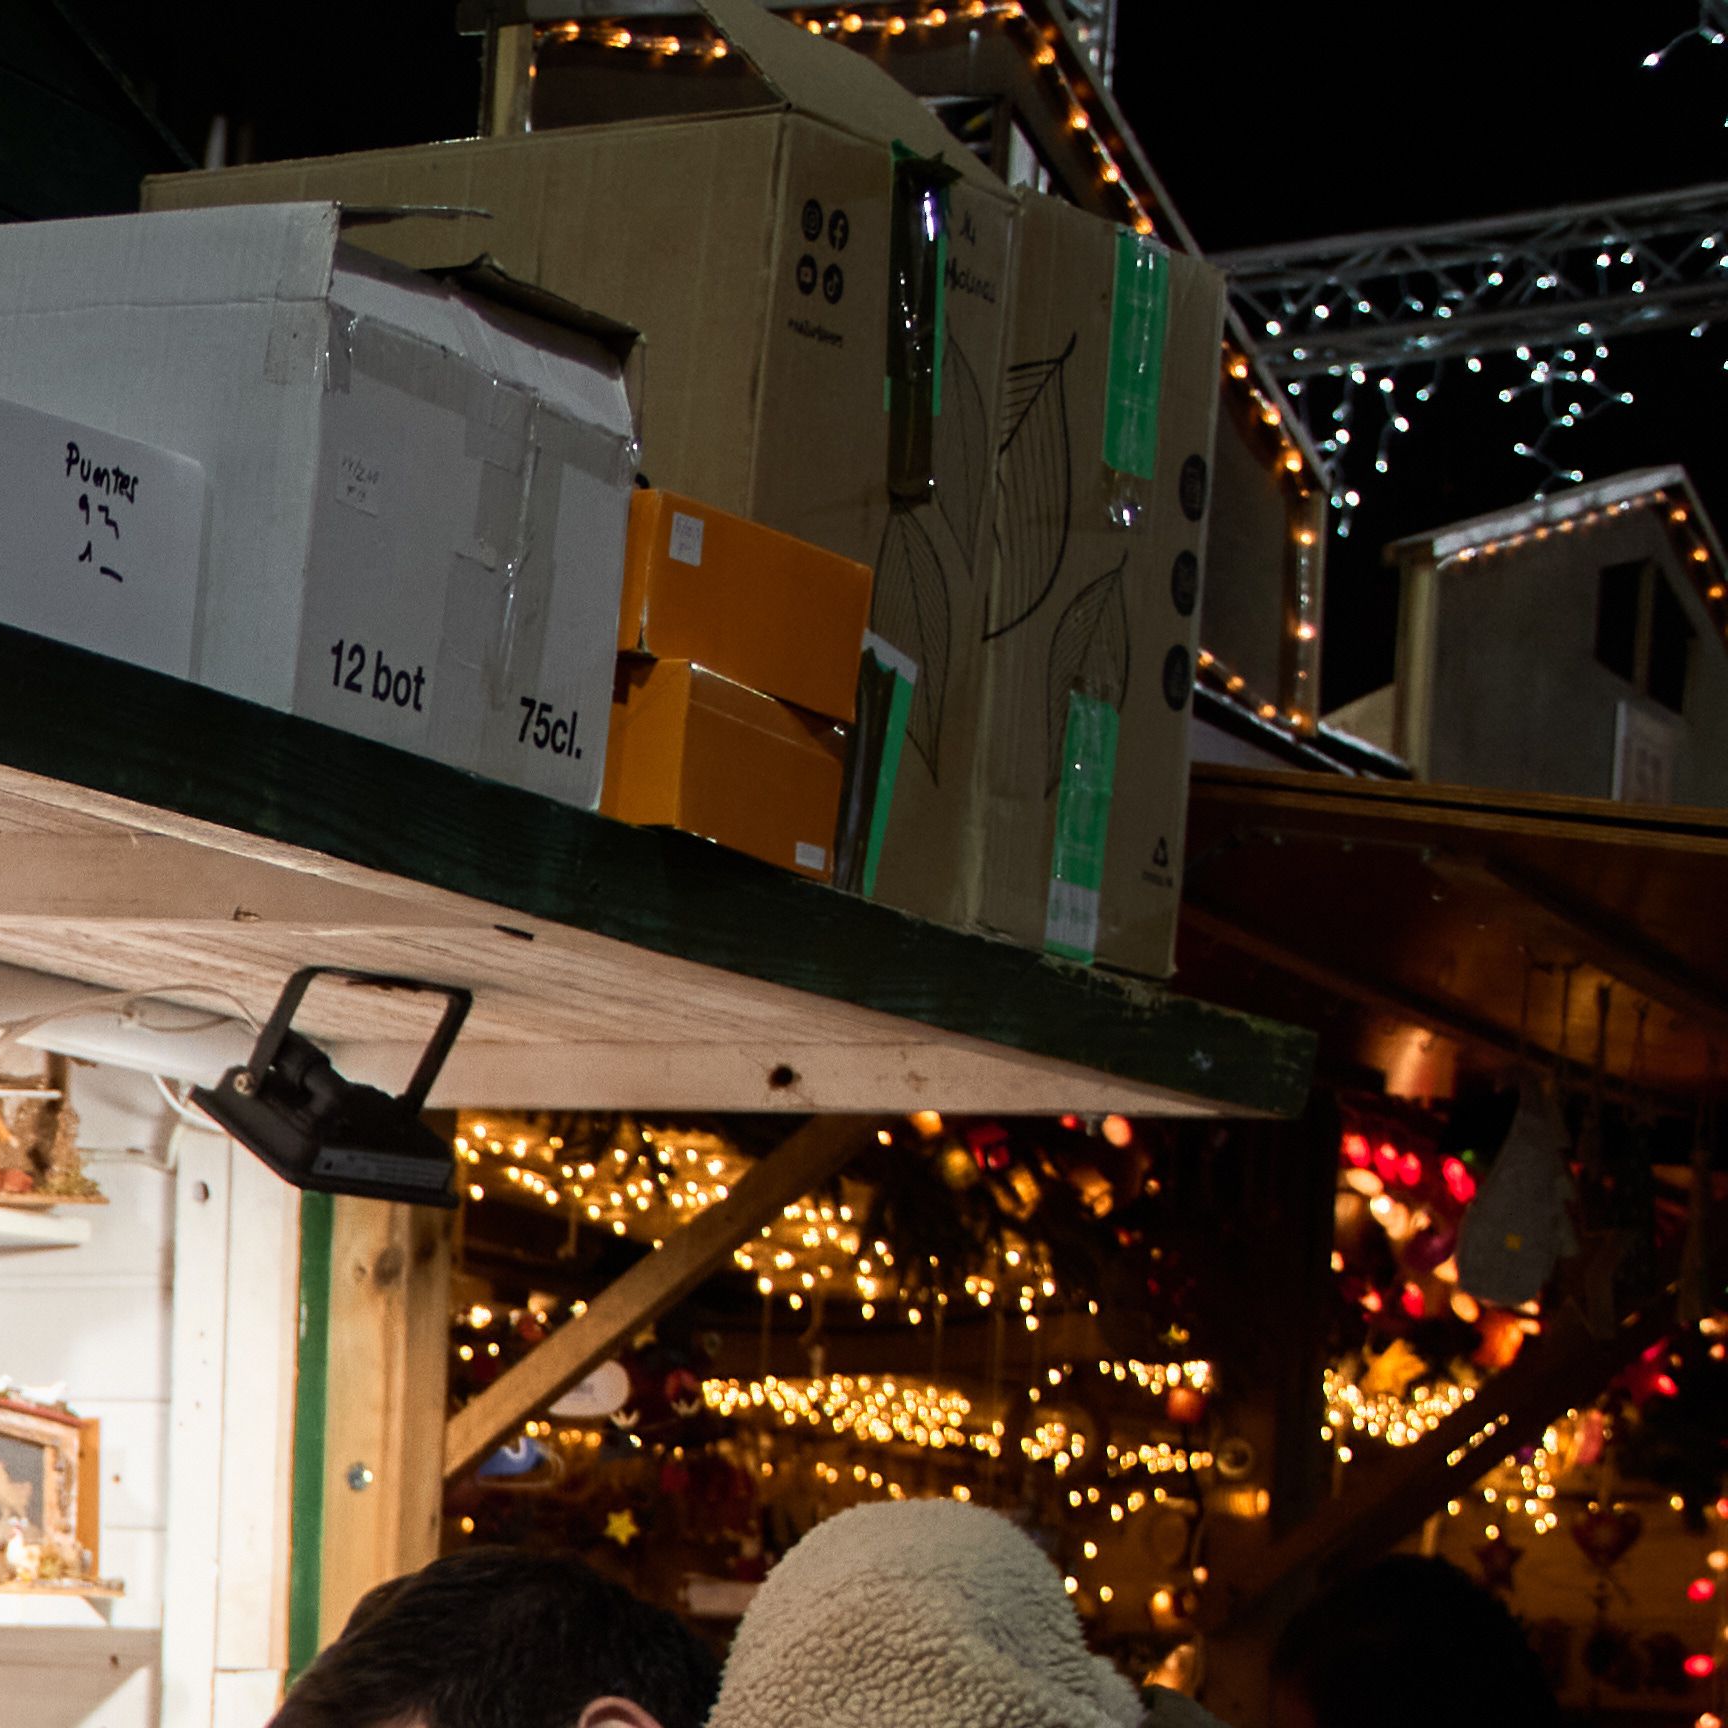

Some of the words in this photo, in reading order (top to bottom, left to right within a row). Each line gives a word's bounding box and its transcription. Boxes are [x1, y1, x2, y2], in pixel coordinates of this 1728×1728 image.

[331, 639, 366, 693] 12
[372, 650, 426, 712] bot
[518, 696, 583, 760] 75cl.
